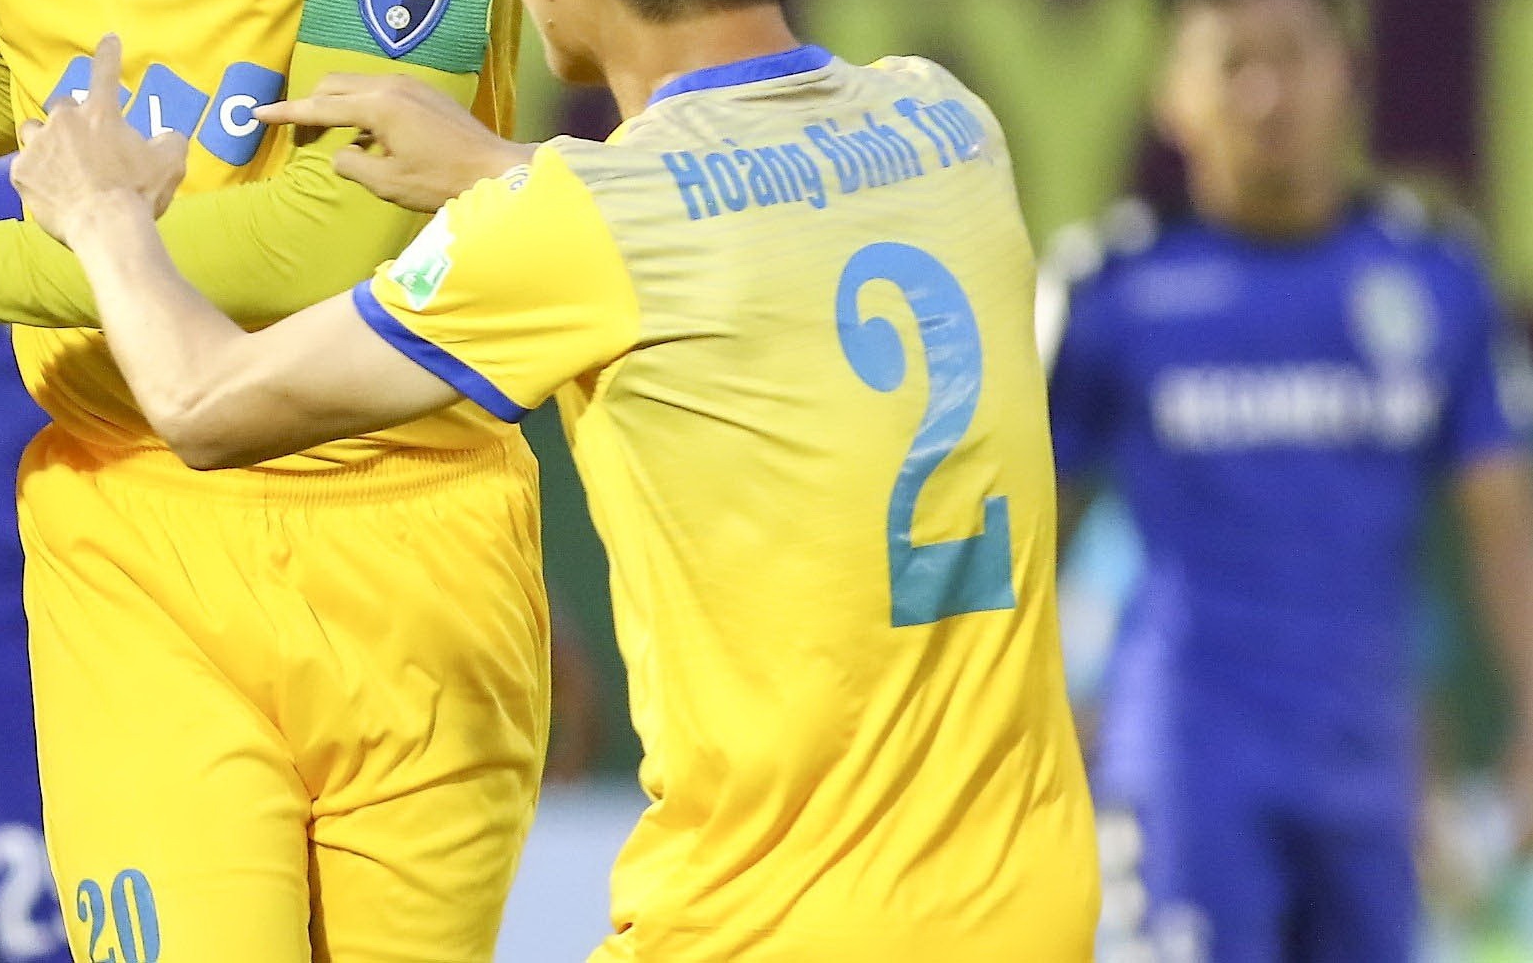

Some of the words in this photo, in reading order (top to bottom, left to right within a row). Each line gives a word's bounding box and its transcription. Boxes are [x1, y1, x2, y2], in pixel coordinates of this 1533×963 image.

[662, 138, 828, 221] Hoàng
[834, 241, 1016, 627] 2
[76, 869, 161, 963] 20
